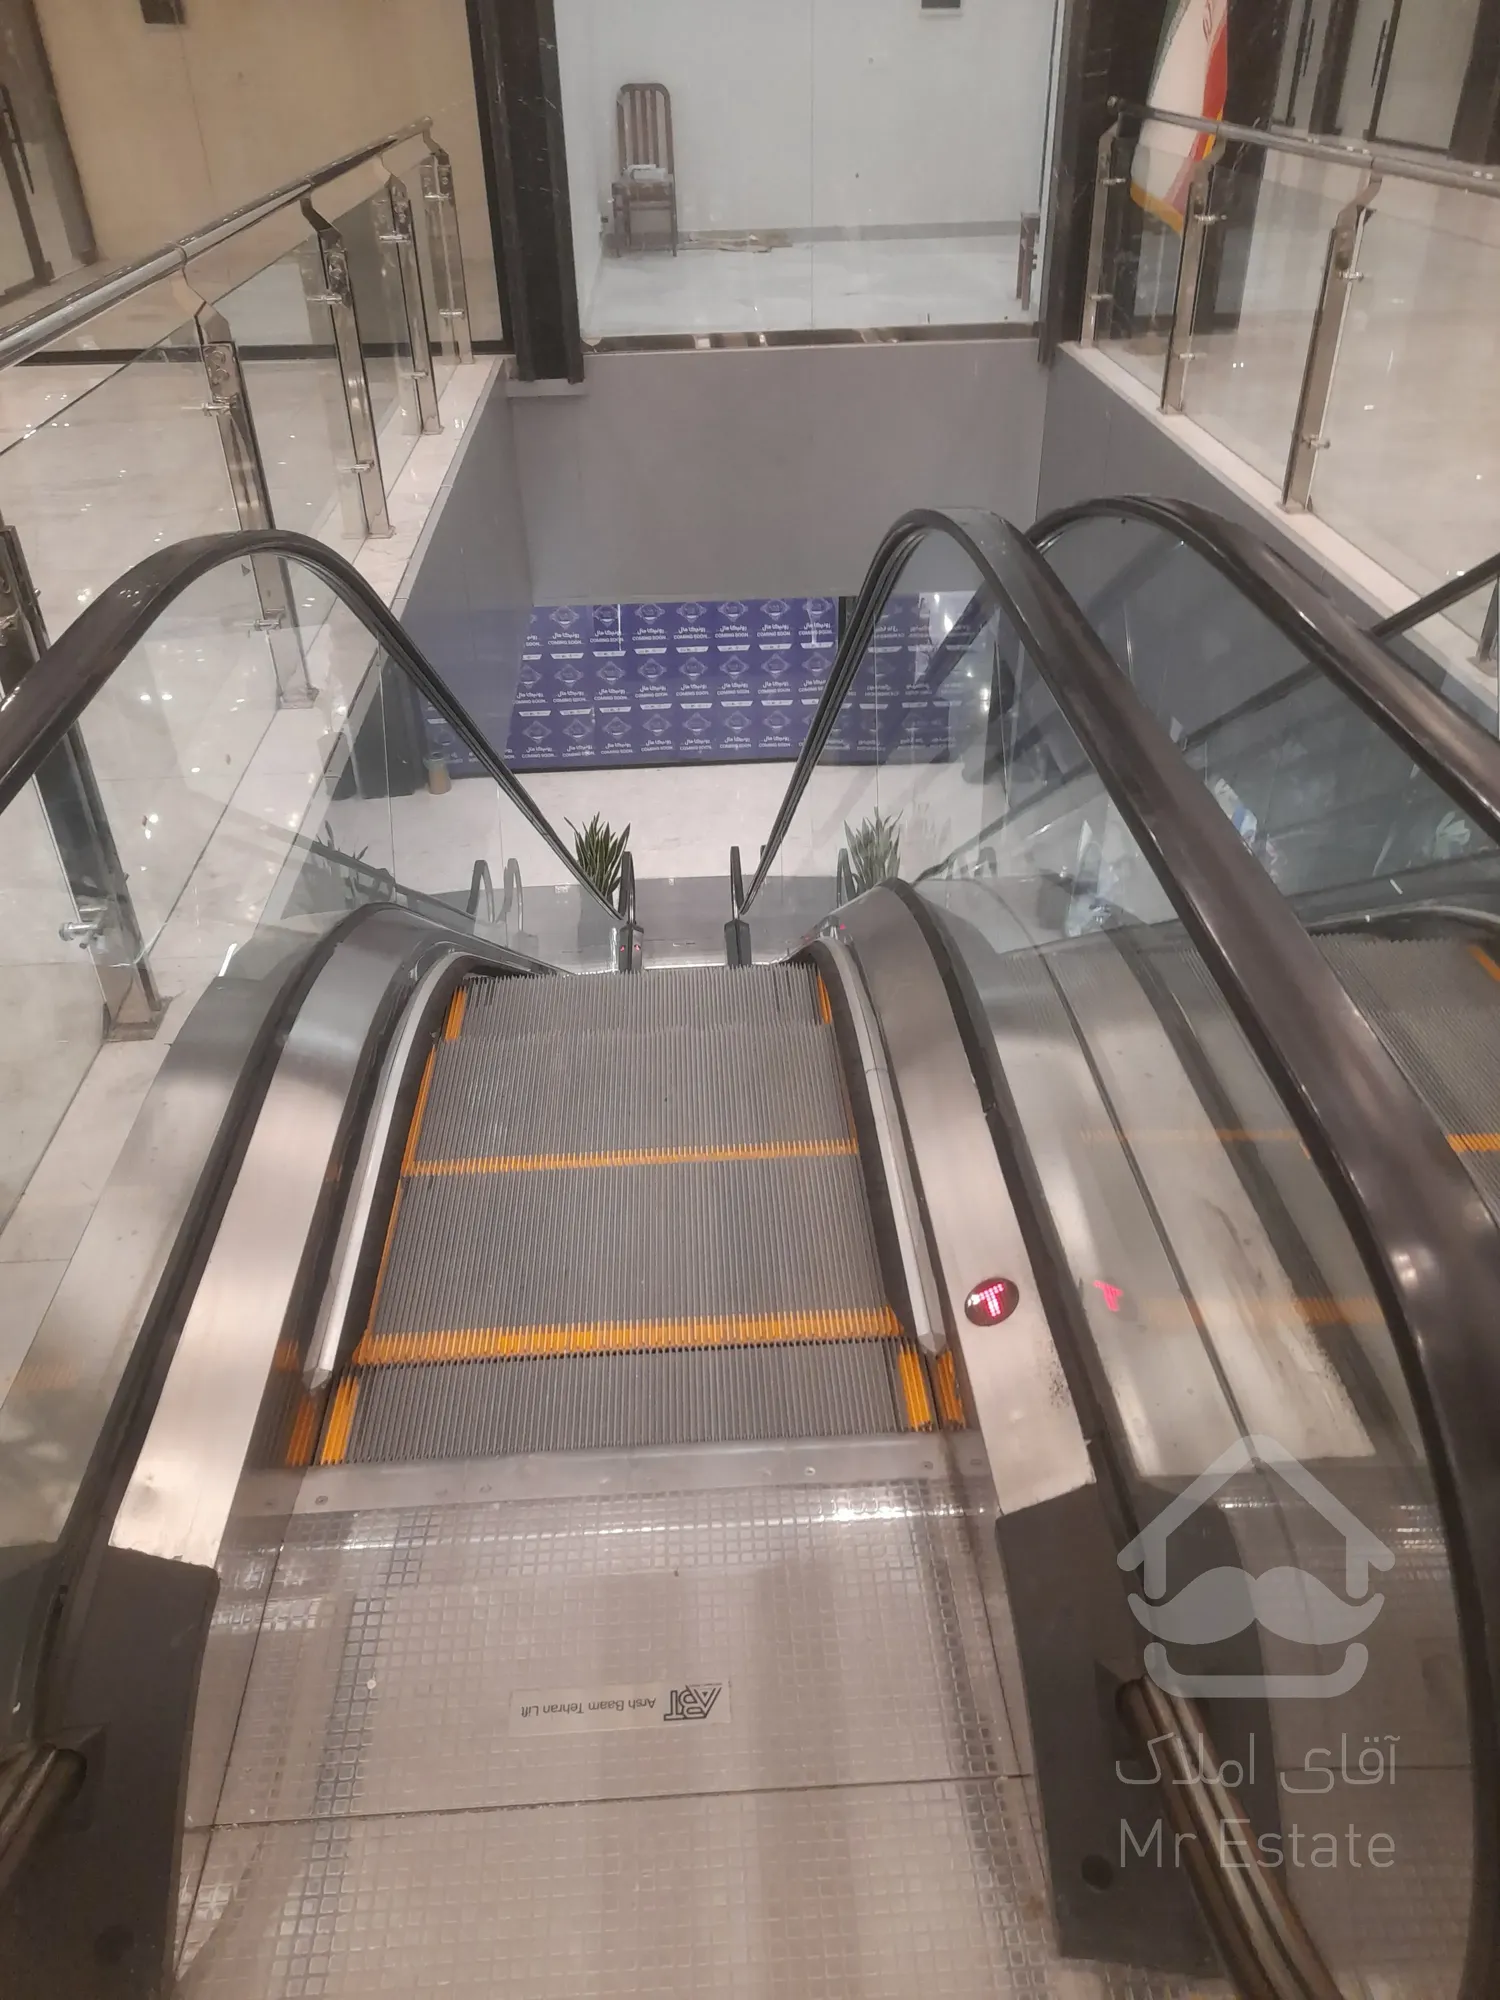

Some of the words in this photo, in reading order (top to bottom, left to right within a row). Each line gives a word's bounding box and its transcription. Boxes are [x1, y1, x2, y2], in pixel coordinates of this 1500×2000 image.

[542, 1702, 585, 1715] Tehran
[588, 1699, 625, 1712] Baam
[628, 1697, 657, 1709] Arsh
[520, 1705, 539, 1717] Lift
